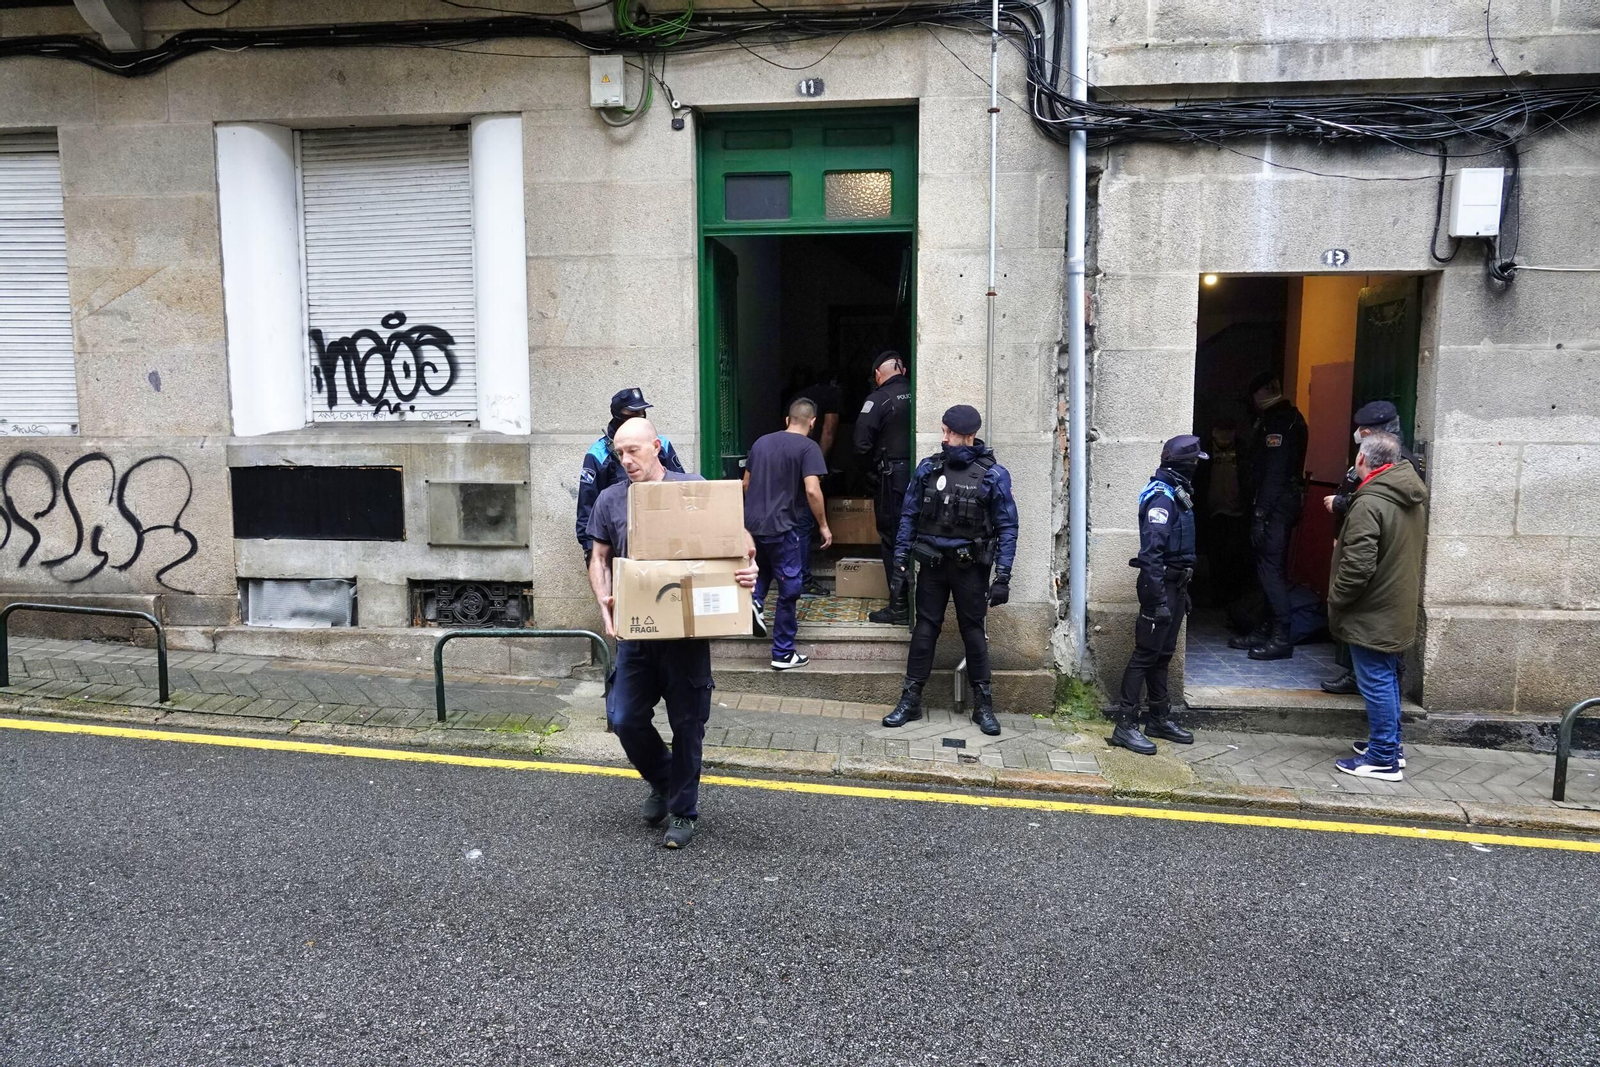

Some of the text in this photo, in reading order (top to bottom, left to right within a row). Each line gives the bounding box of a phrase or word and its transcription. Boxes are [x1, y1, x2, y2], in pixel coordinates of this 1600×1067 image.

[799, 79, 815, 95] 11
[1325, 250, 1345, 266] 13
[629, 626, 660, 634] FRAGIL
